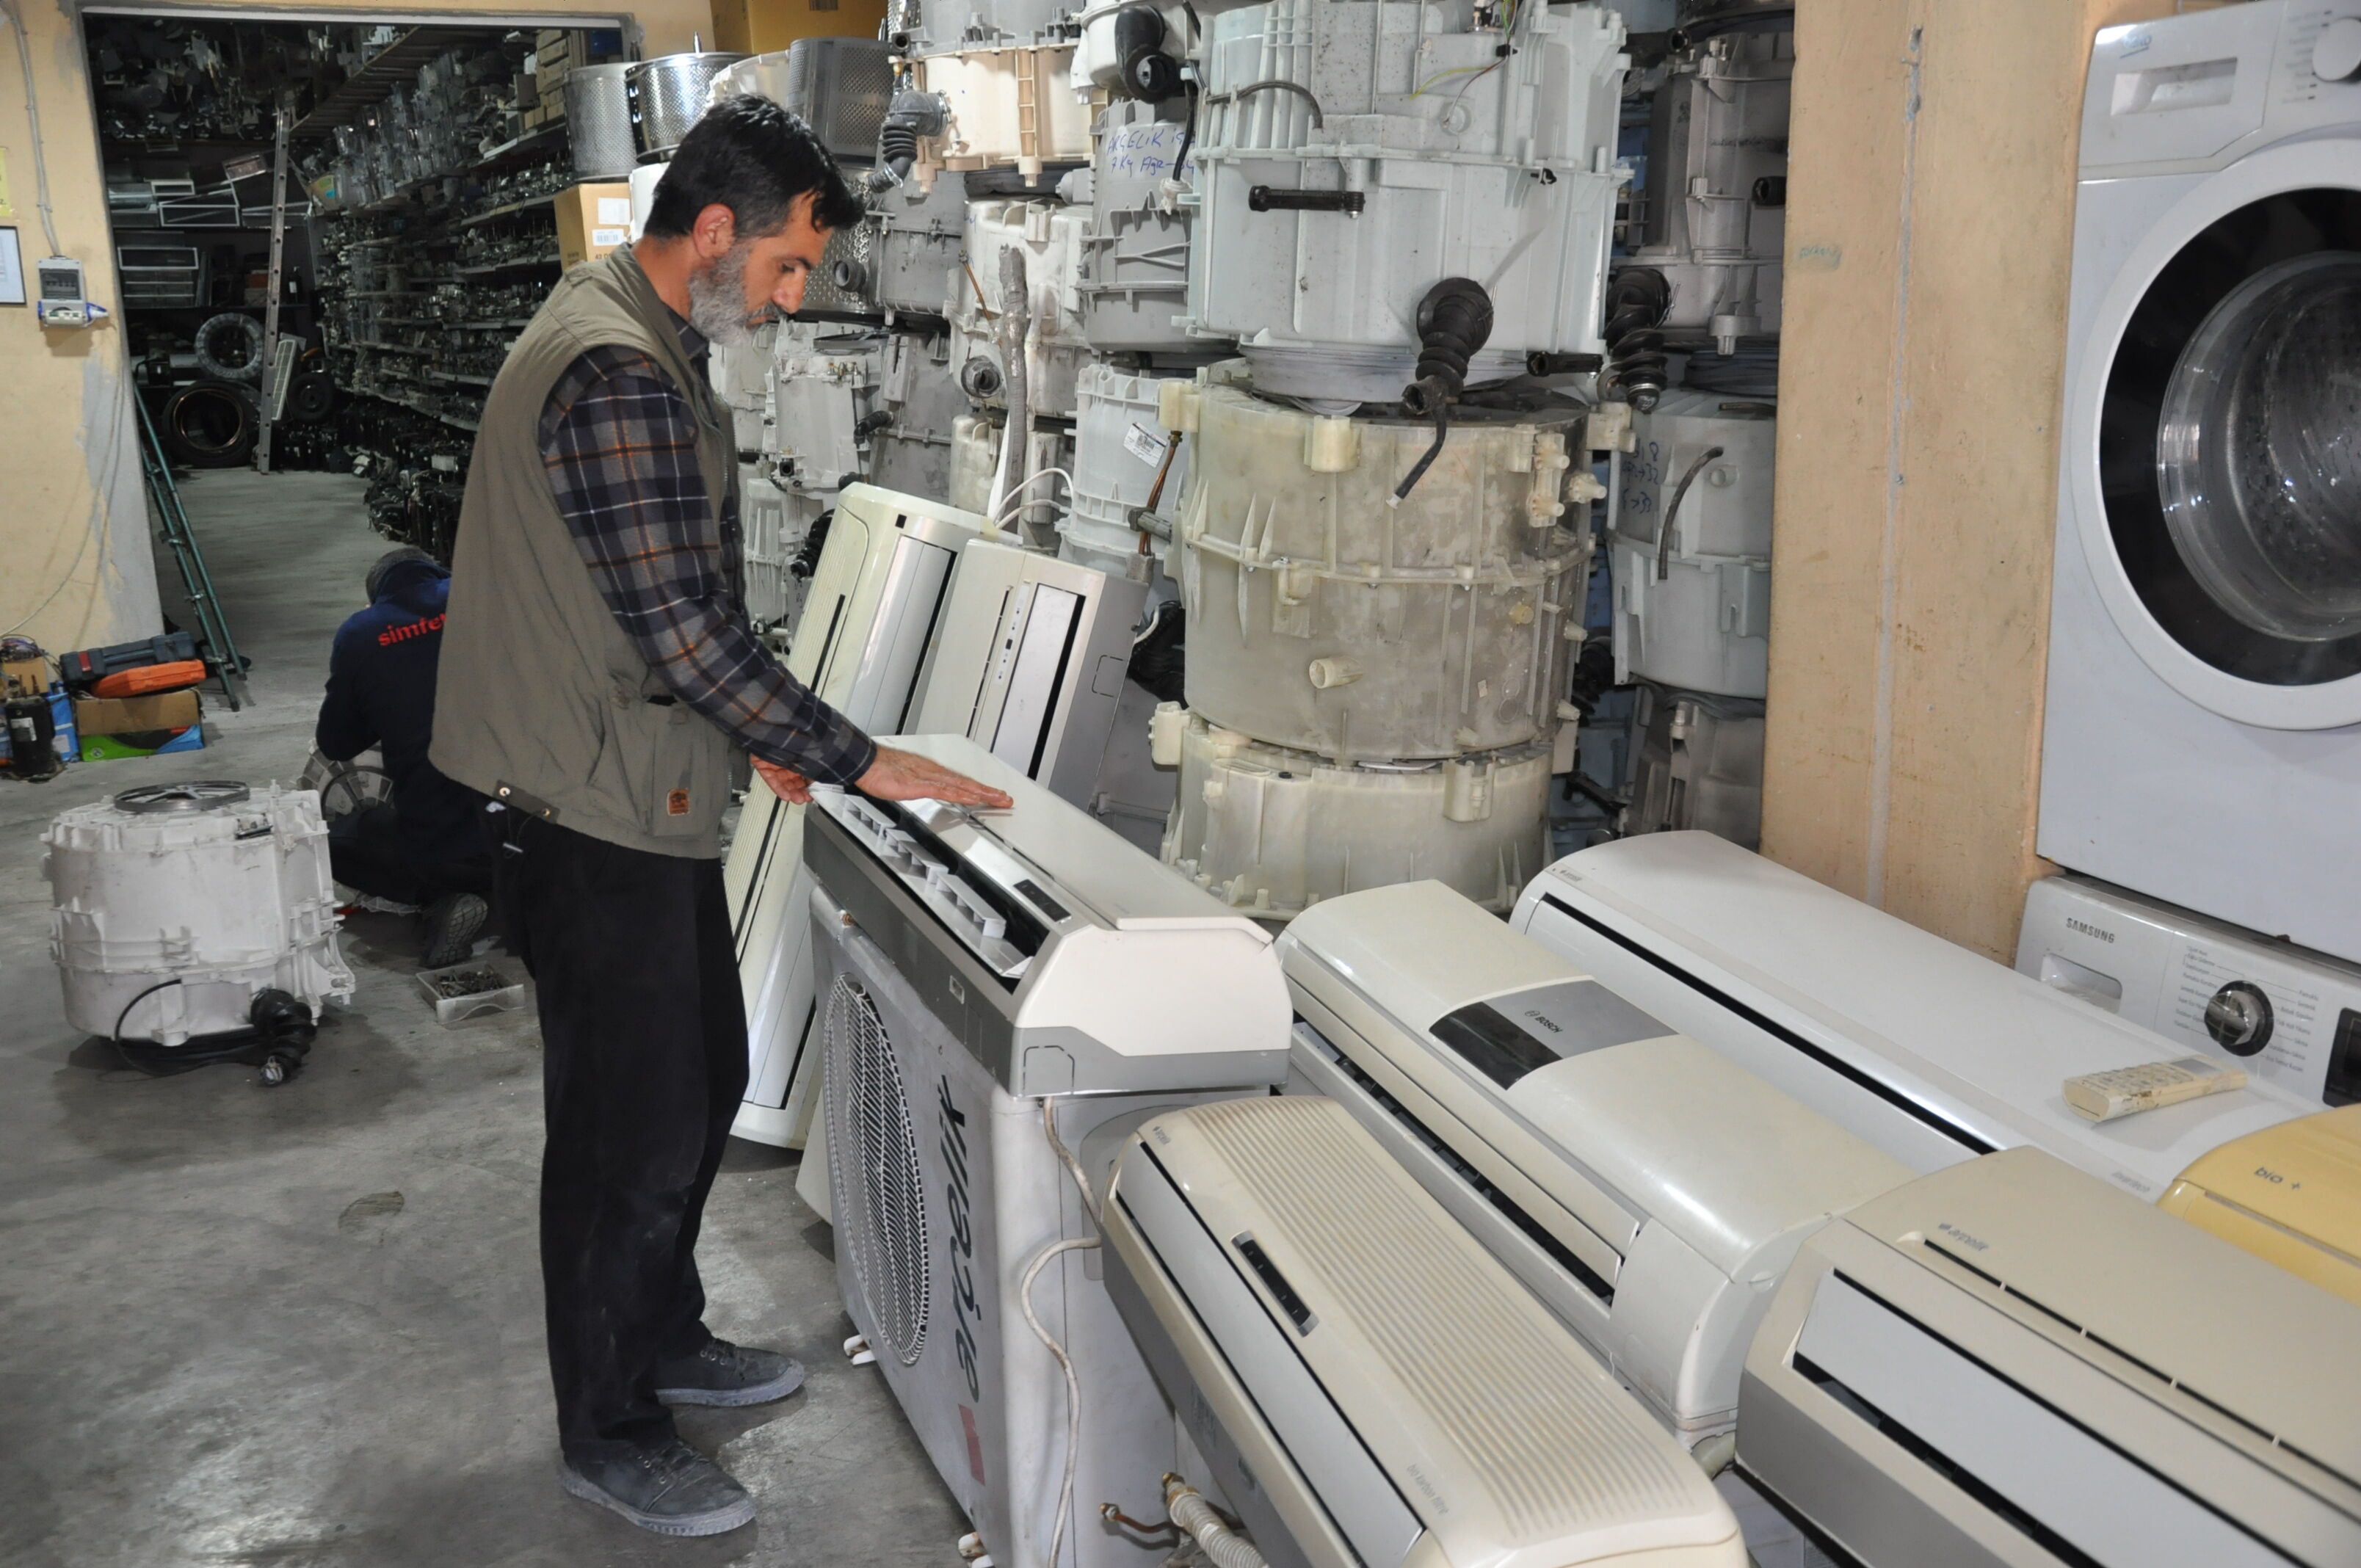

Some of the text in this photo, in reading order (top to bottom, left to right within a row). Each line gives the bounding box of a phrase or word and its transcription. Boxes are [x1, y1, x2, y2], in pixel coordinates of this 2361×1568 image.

[2066, 918, 2115, 944] SAMSUNG
[1535, 1016, 1563, 1033] BOSCH
[2254, 1167, 2284, 1183] bio
[937, 1074, 981, 1403] arçelik
